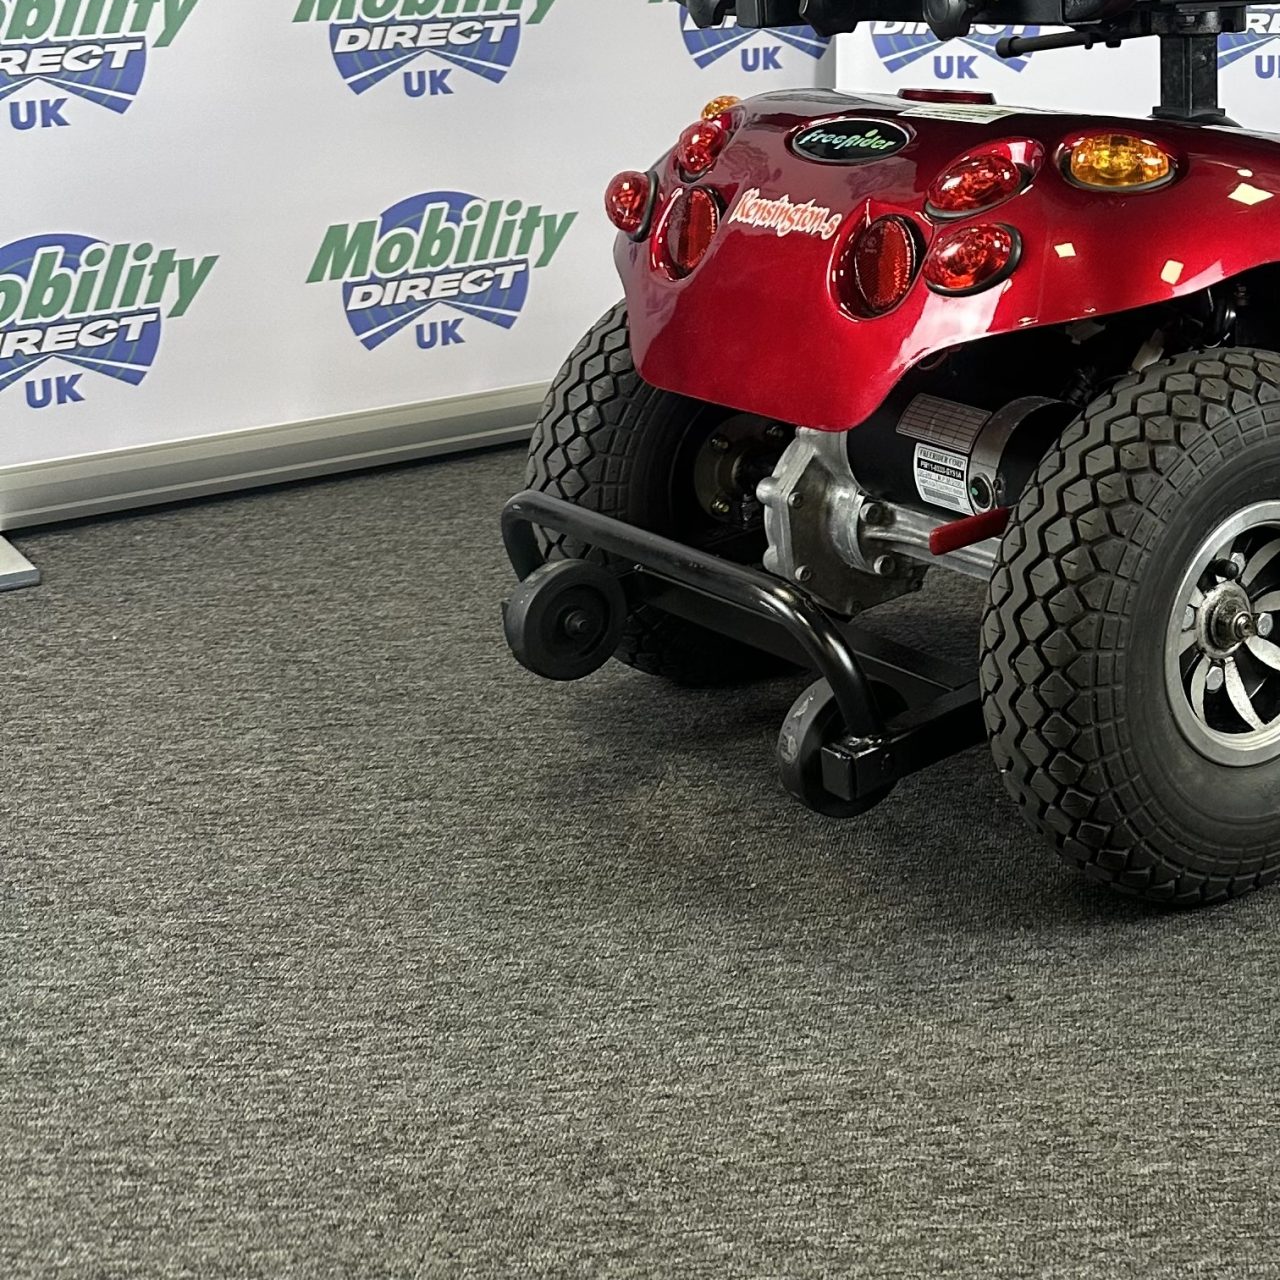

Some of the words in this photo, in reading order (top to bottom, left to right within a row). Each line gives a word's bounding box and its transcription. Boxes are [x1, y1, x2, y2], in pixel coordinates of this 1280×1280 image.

[333, 20, 517, 53] DIRECT
[0, 42, 143, 75] RECT
[741, 46, 782, 72] UK
[934, 56, 978, 79] UK
[403, 69, 454, 97] UK
[9, 97, 71, 131] UK
[305, 199, 579, 284] Mobility
[346, 263, 527, 311] DIRECT
[0, 313, 158, 359] RECT
[415, 318, 465, 349] UK
[25, 373, 85, 409] UK
